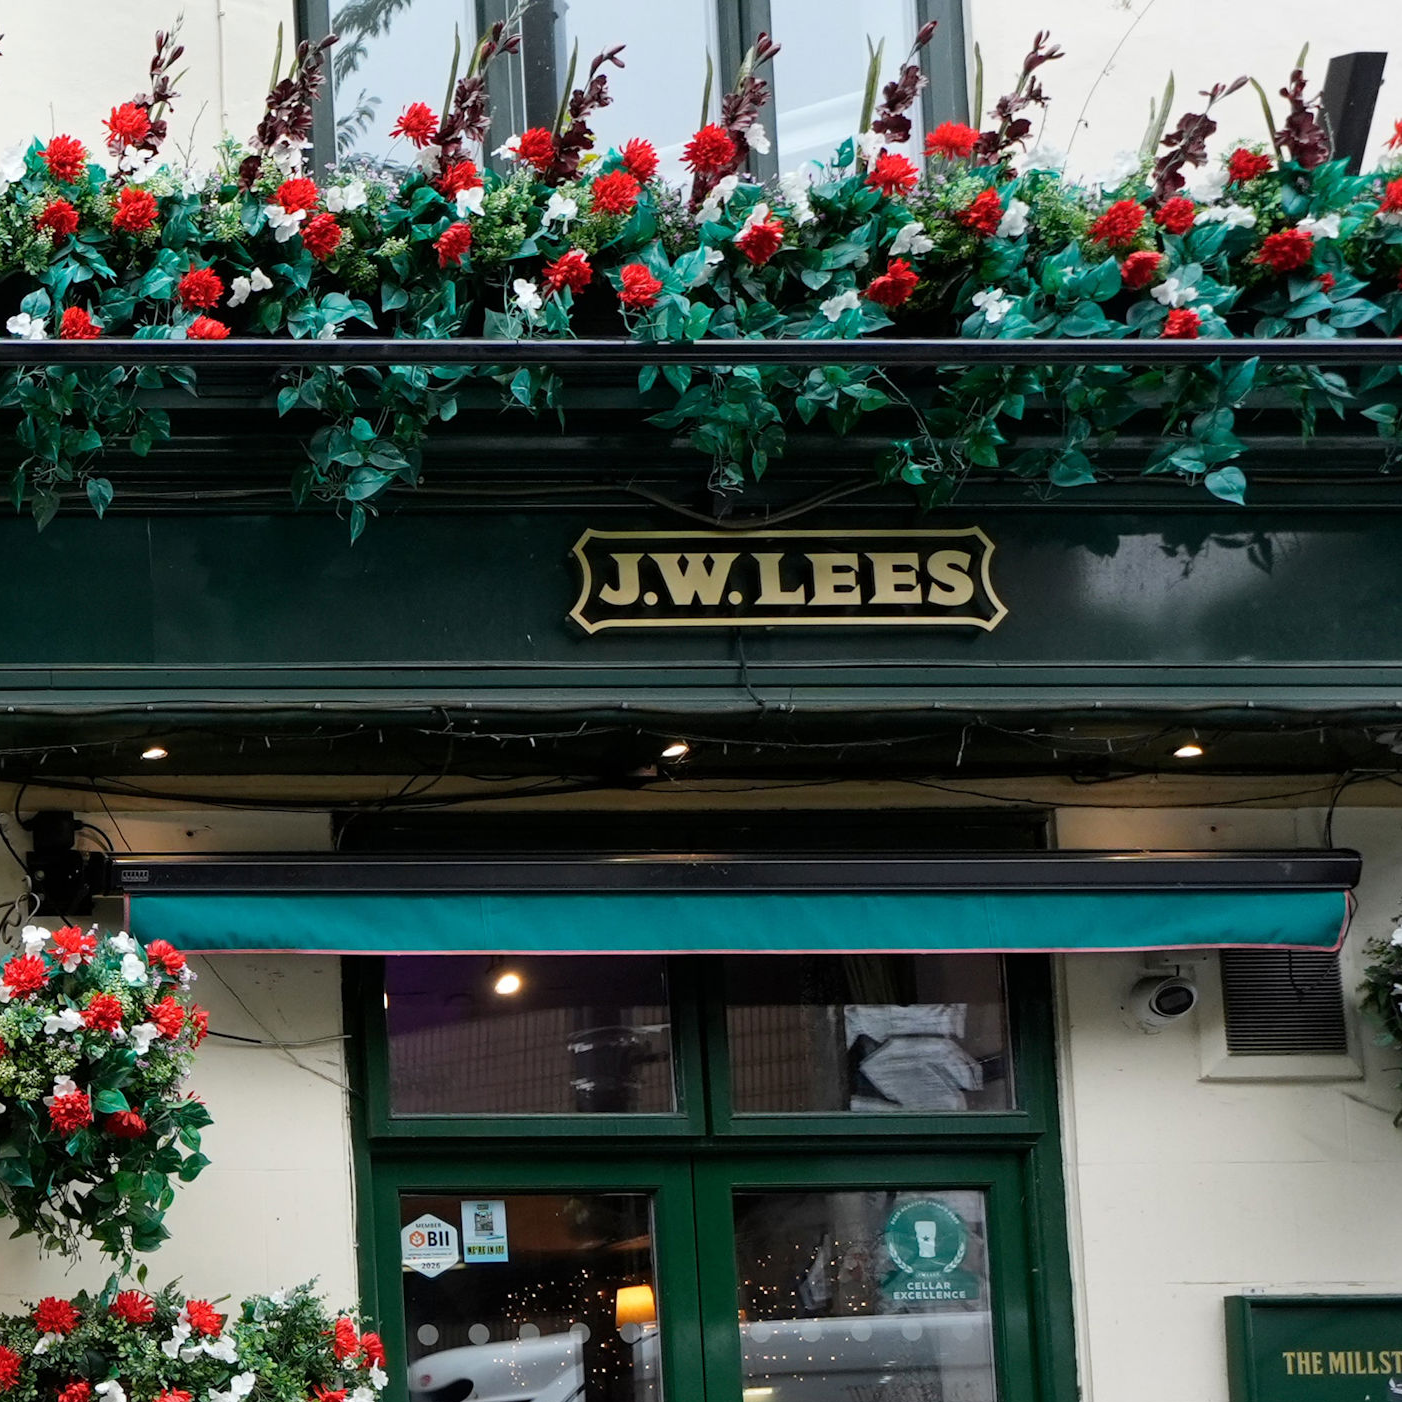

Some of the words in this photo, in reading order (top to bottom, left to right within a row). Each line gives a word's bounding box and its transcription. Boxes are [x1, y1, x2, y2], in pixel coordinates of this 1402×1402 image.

[427, 1231, 450, 1246] BII
[907, 1282, 951, 1290] CELLAR
[893, 1291, 967, 1300] EXCELLENCE
[1282, 1351, 1324, 1376] THE
